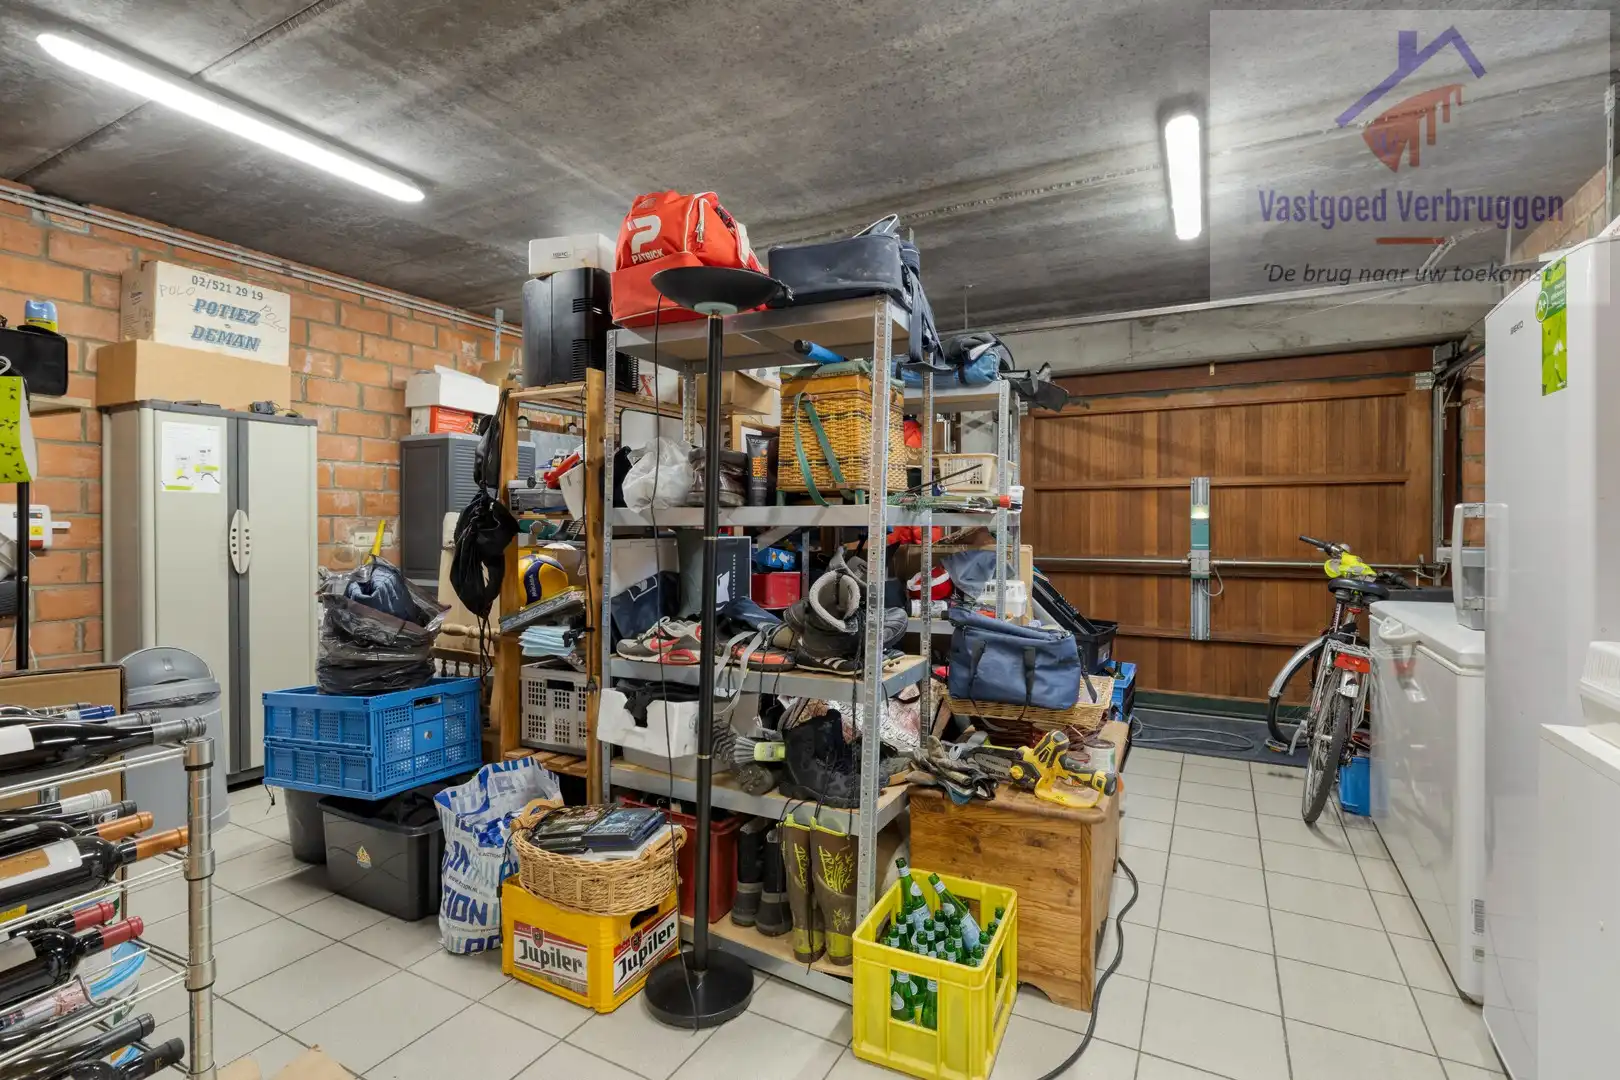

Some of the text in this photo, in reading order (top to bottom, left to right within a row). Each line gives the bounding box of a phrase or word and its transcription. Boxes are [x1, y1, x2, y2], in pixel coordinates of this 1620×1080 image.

[631, 248, 665, 265] PATRICK
[158, 284, 196, 298] POLO
[191, 275, 264, 301] 02/521 29 19
[193, 297, 262, 326] POTIEZ
[259, 303, 288, 334] POLO
[190, 325, 262, 353] DEMAN
[518, 938, 585, 974] Jupiler
[617, 920, 676, 983] Jupiler
